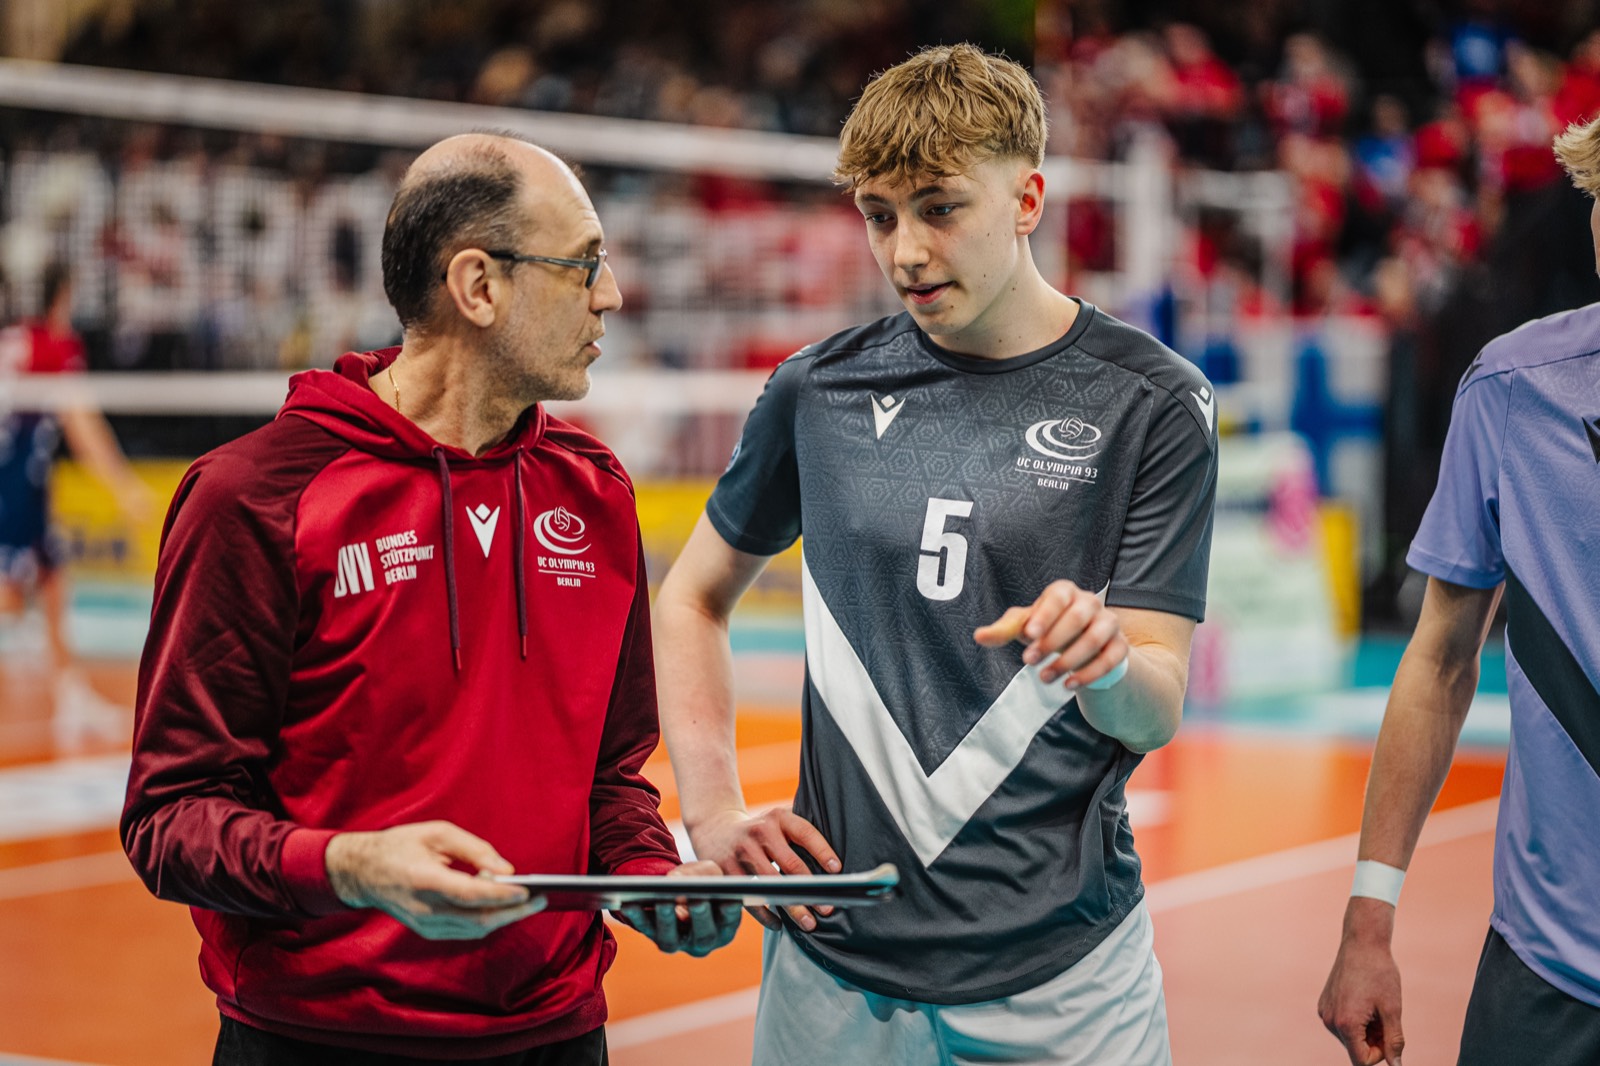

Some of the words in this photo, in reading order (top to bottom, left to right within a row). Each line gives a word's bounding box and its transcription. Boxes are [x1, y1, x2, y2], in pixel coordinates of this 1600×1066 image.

[1032, 459, 1083, 476] OLYMPIA
[1084, 466, 1098, 479] 93
[1037, 477, 1070, 491] BERLIN
[375, 529, 418, 553] BUNDES
[916, 497, 975, 601] 5
[379, 544, 435, 570] STÜTZPUNKT
[548, 557, 585, 571] OLYMPIA
[585, 561, 595, 573] 93
[384, 565, 417, 585] BERLIN
[556, 576, 581, 588] BERLIN
